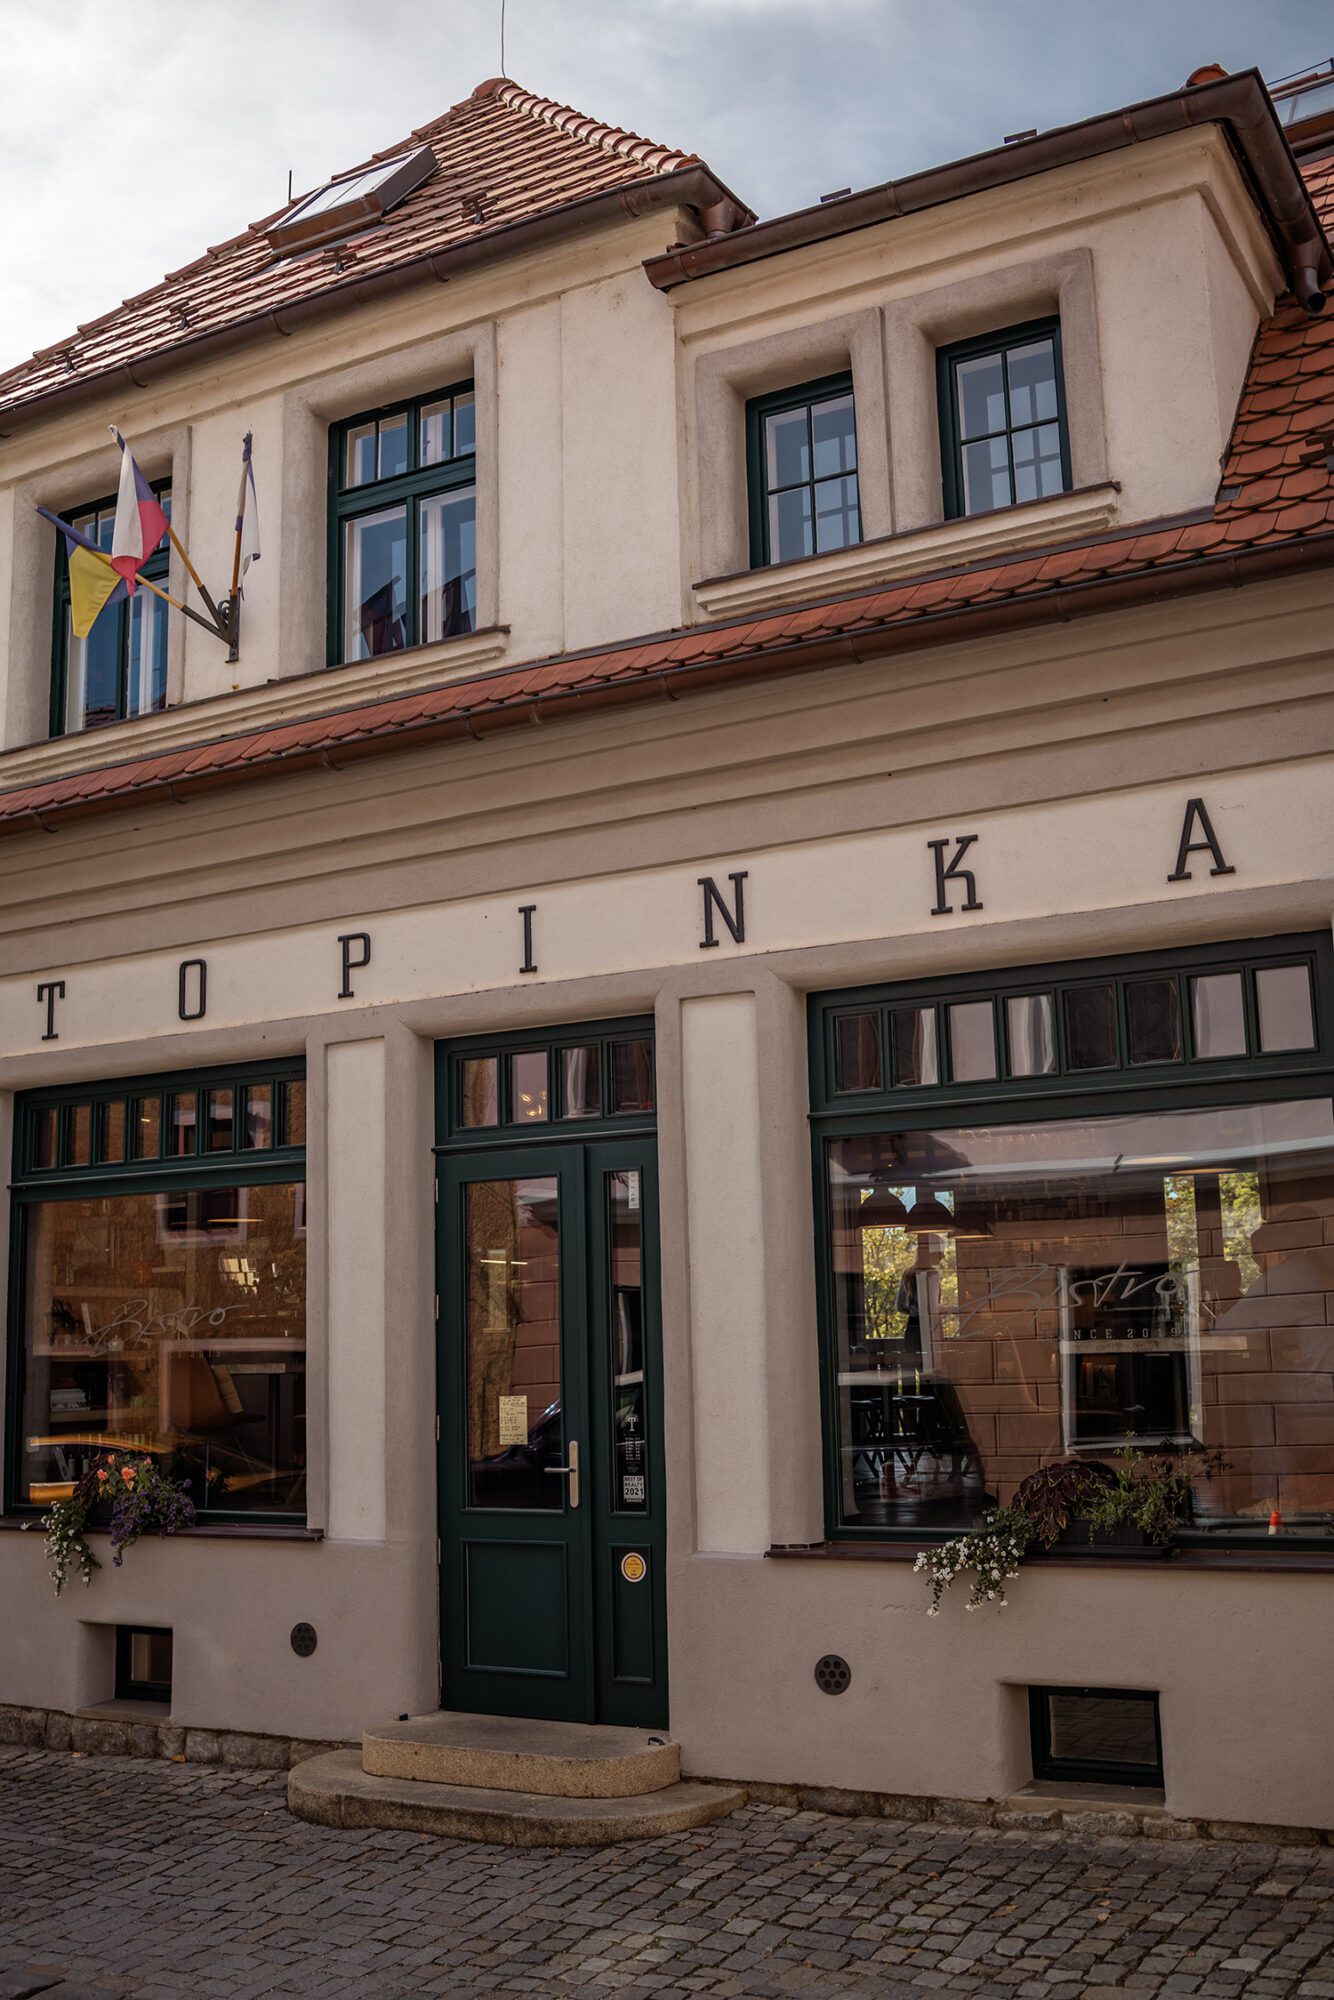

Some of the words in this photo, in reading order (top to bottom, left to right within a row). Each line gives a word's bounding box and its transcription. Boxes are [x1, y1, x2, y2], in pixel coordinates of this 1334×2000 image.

[37, 798, 1235, 1040] TOPINKA
[81, 1299, 248, 1358] Bistro
[933, 1259, 1223, 1340] Bistro
[1126, 1327, 1177, 1339] 2019
[625, 1487, 643, 1496] 2021
